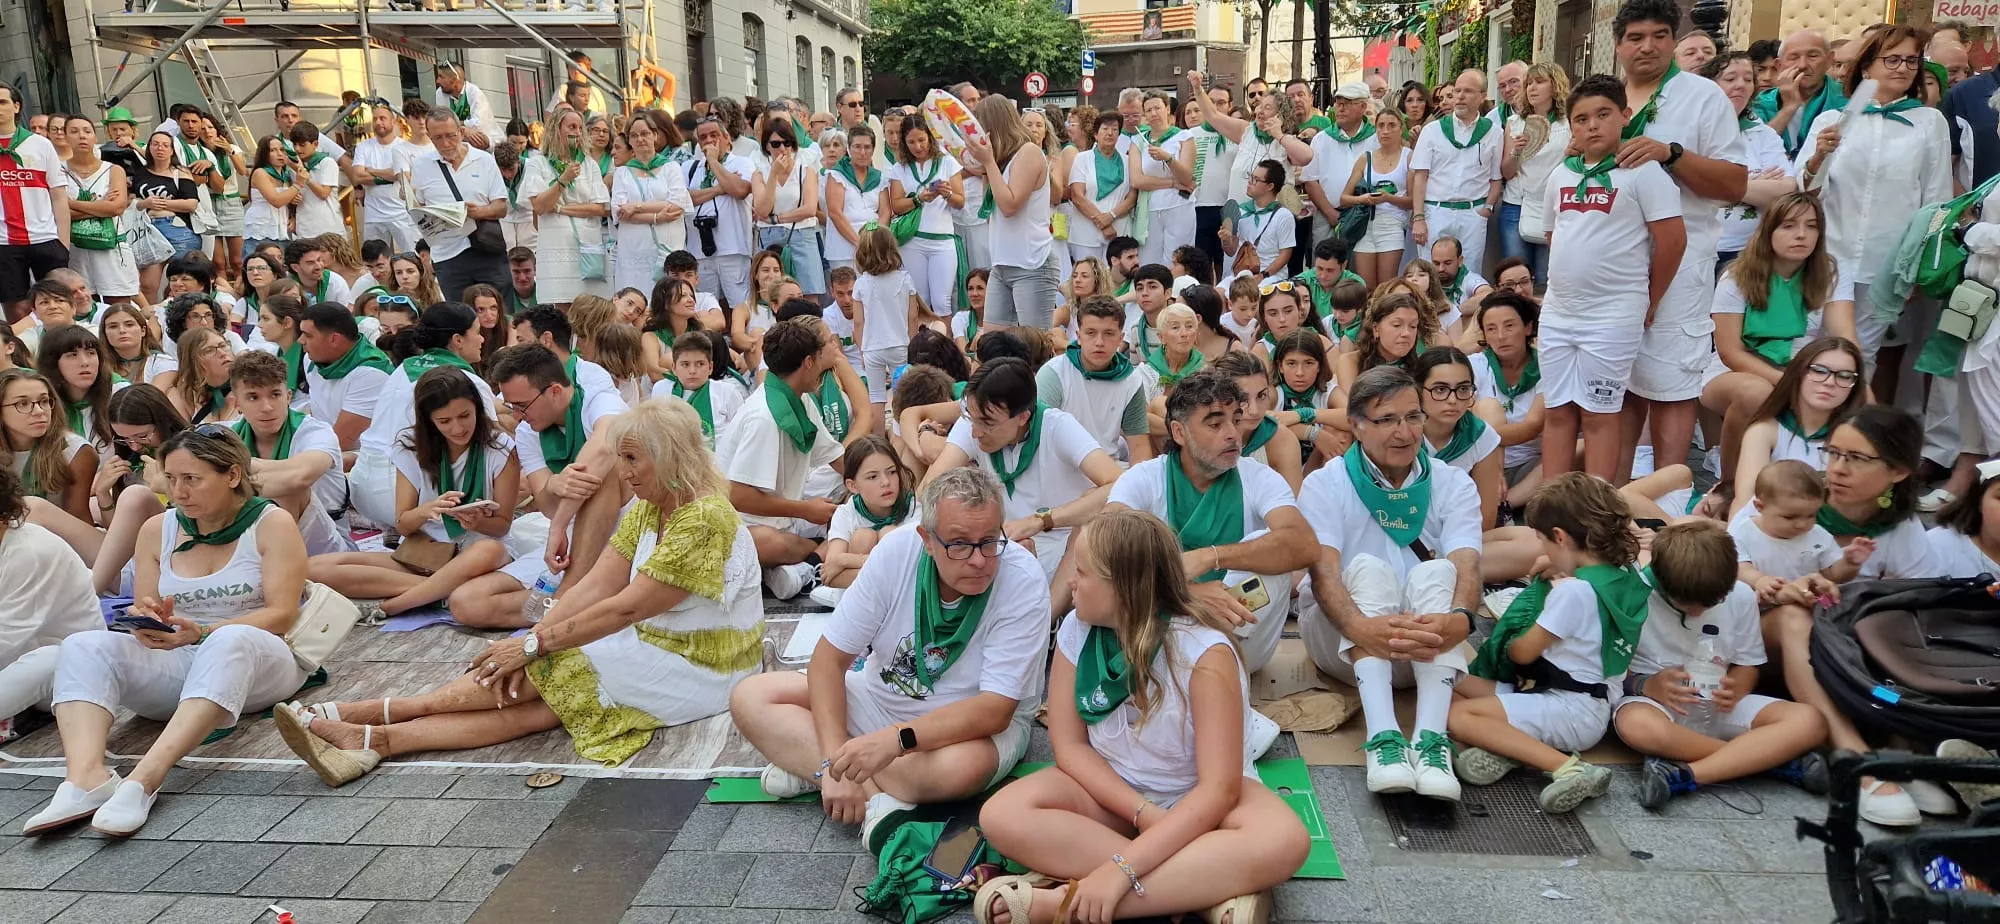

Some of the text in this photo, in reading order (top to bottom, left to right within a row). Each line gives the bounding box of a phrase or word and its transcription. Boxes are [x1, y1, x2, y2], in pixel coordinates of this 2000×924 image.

[1937, 0, 2000, 22] Rebaja
[0, 169, 34, 181] esca
[1563, 192, 1609, 205] LEVI'S
[1376, 509, 1409, 530] Parrilla
[167, 582, 254, 605] PERANZA
